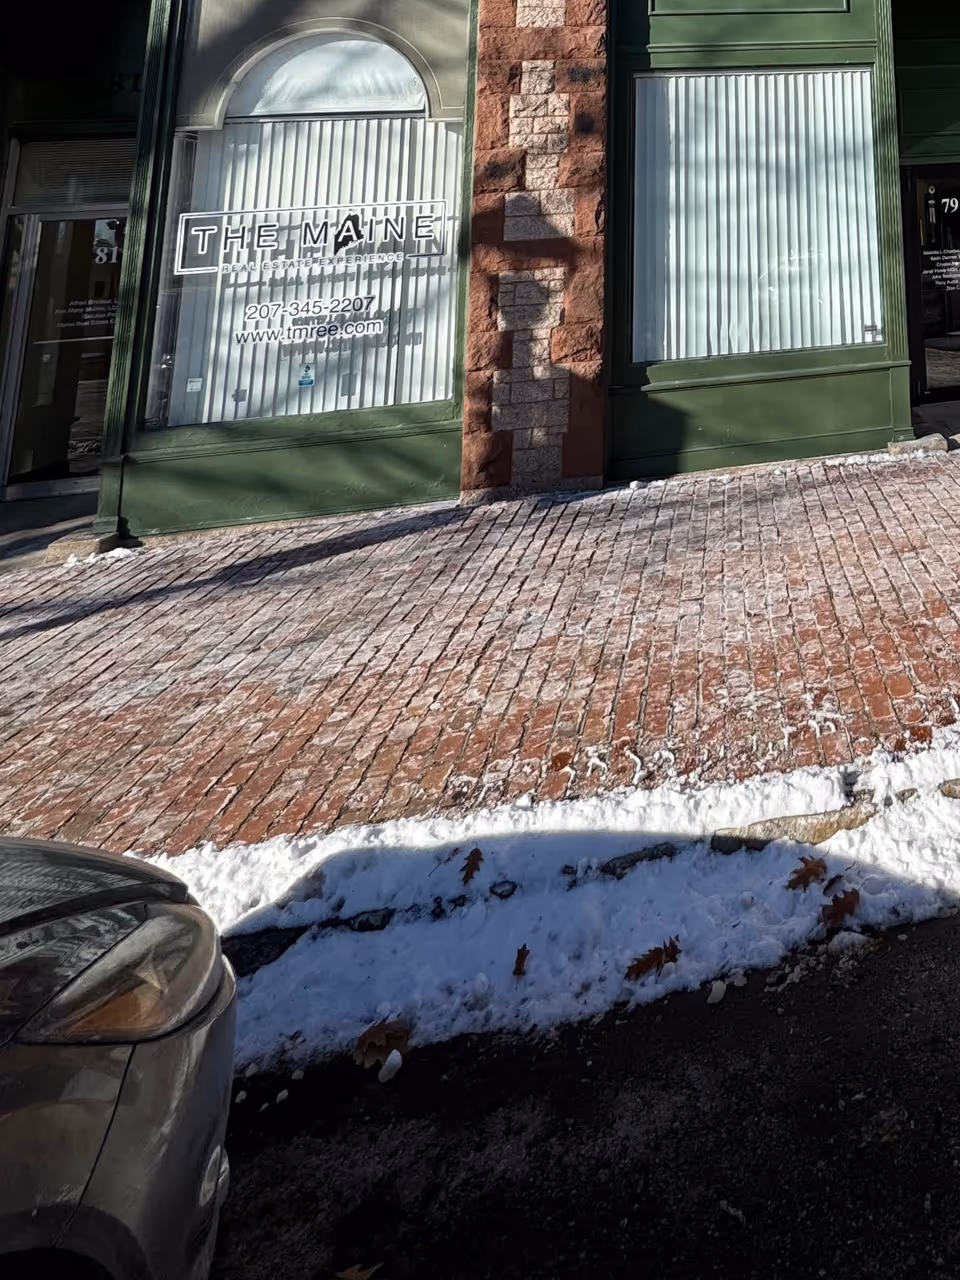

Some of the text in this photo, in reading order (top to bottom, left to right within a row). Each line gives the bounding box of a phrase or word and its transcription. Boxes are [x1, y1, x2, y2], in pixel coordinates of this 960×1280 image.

[191, 215, 435, 254] THE MAINE
[95, 246, 119, 264] 81
[221, 252, 404, 273] REAL ESTATE EXPERIENCE
[245, 295, 376, 321] 207-345-2207
[235, 319, 384, 344] www.tmree.com
